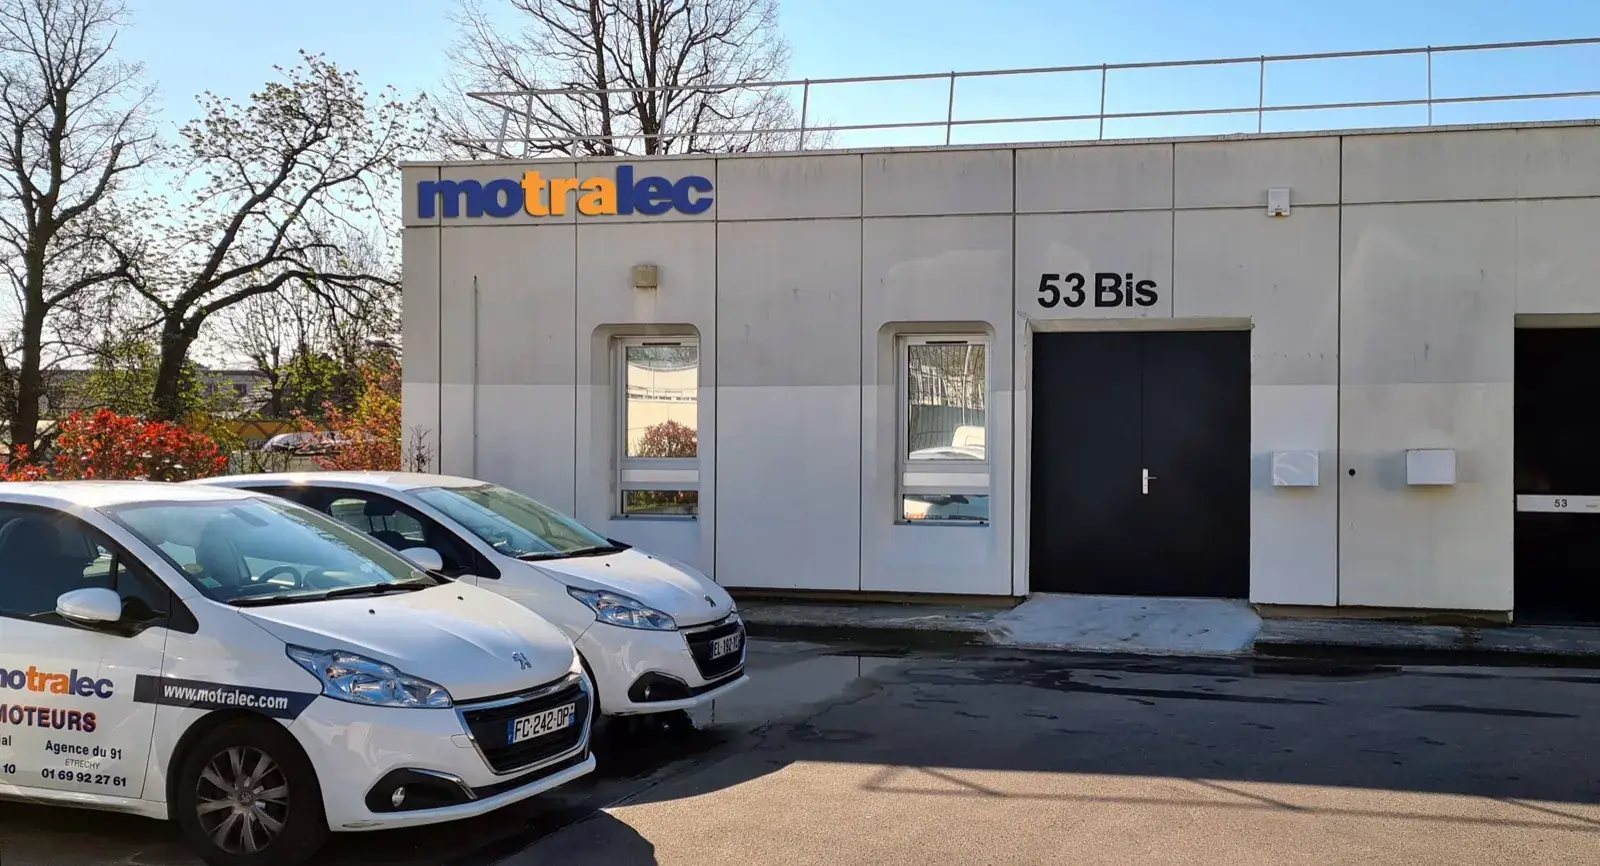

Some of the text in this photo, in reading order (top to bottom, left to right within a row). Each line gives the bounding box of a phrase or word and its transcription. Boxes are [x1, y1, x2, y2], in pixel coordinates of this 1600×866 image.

[418, 165, 714, 218] motralec
[1037, 272, 1158, 308] 53 Bis
[1554, 498, 1568, 508] 53
[0, 666, 114, 699] otralec
[164, 685, 288, 709] www.motralec.com
[514, 706, 569, 740] FC-242-DP
[45, 740, 122, 760] Agence du 91
[3, 763, 16, 774] 10
[64, 758, 101, 770] ETRECHY
[41, 768, 127, 787] 01 69 92 27 61
